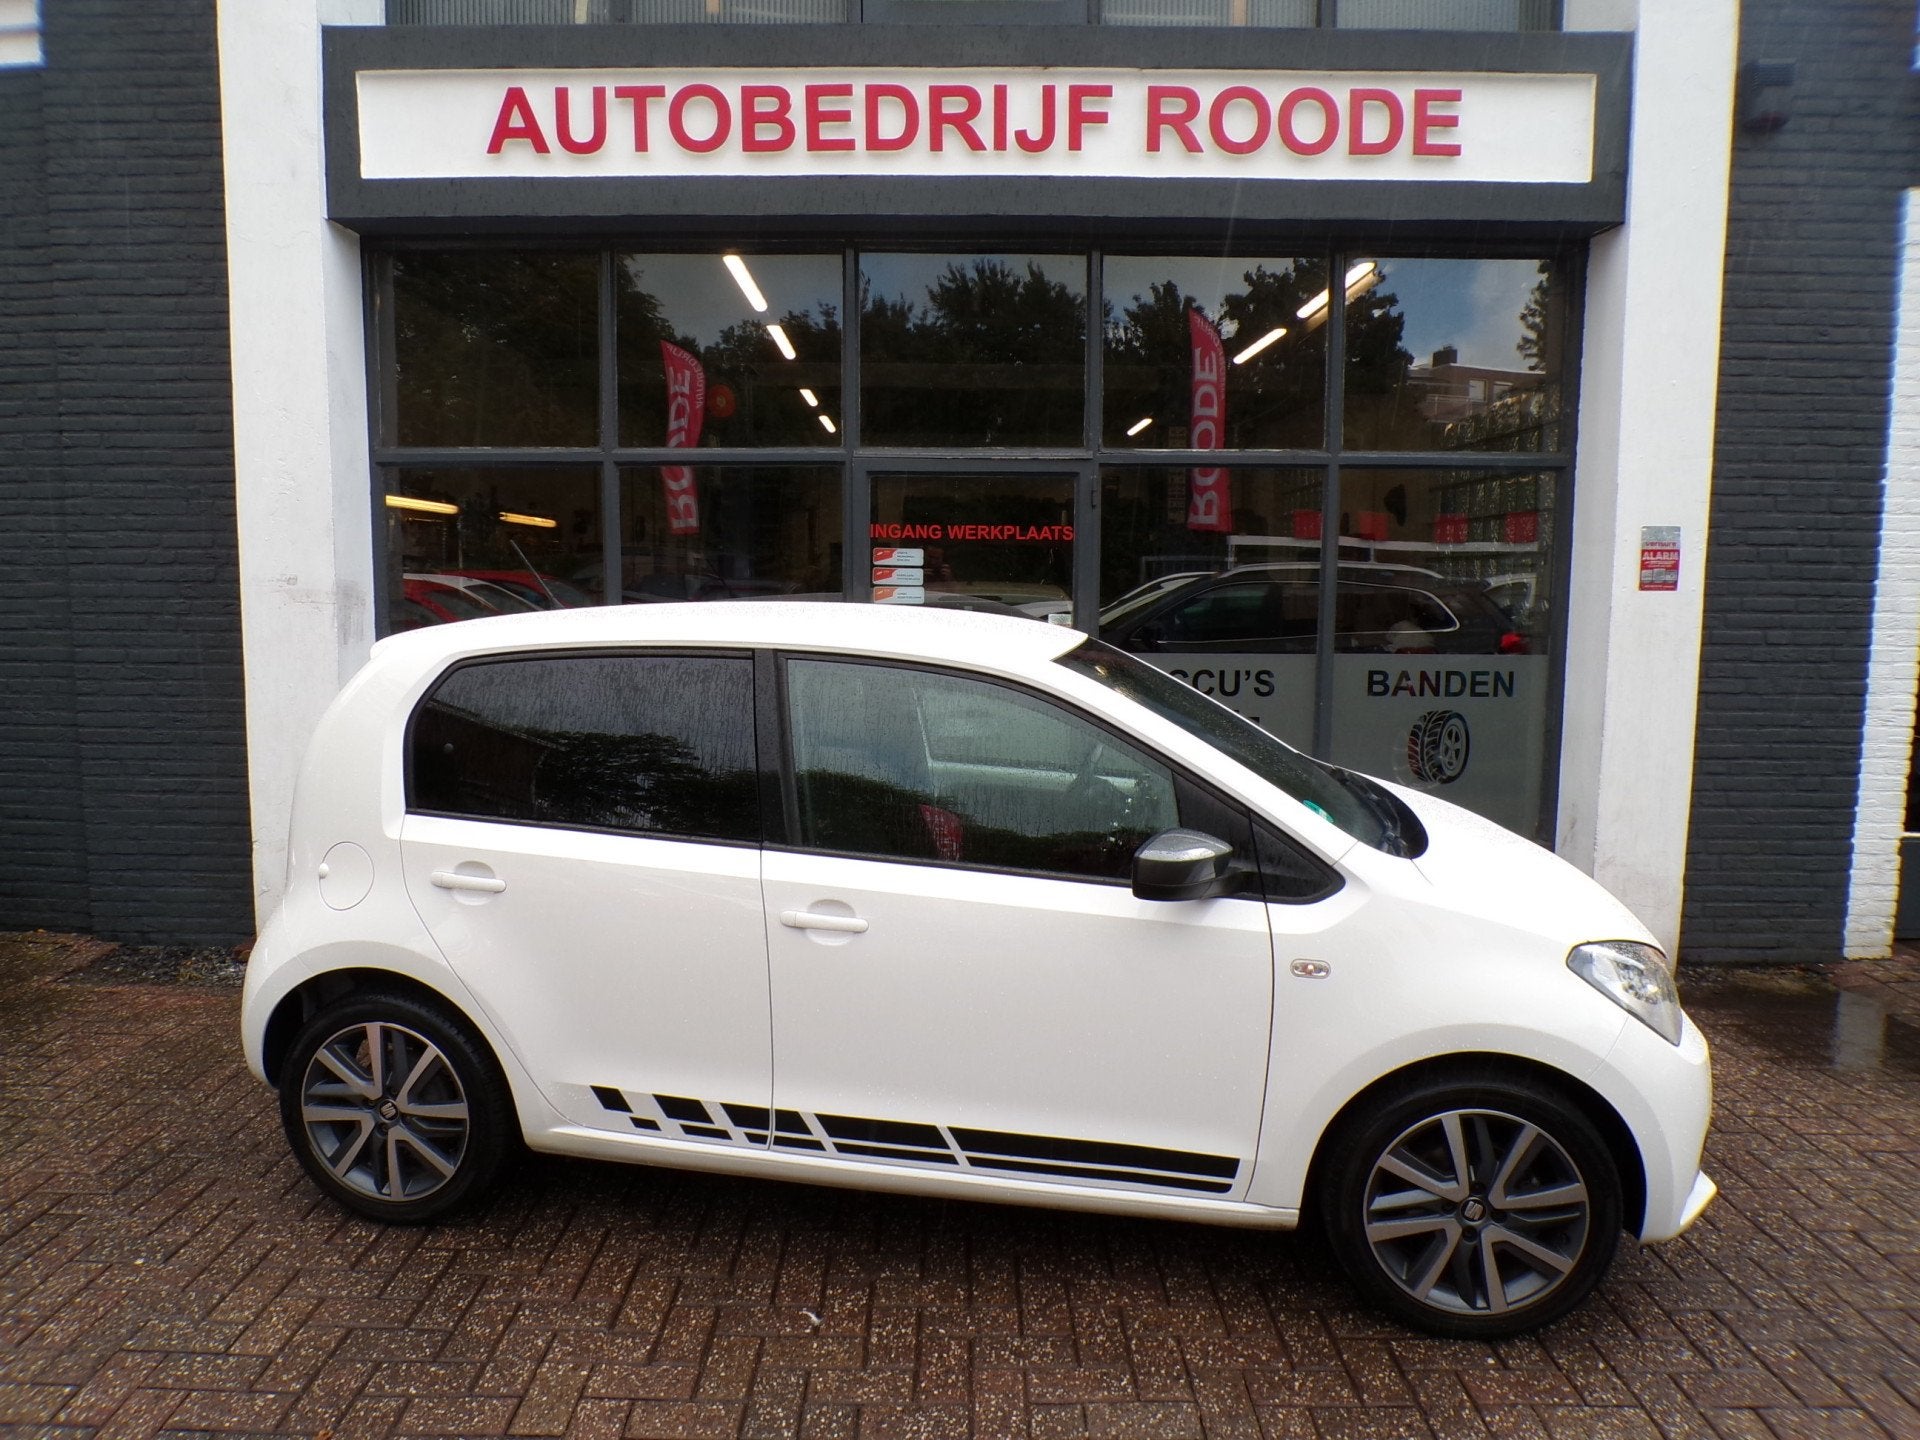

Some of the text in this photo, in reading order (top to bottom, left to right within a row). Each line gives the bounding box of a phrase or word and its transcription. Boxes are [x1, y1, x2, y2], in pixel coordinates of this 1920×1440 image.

[487, 83, 1462, 156] AUTOBEDRIJF ROODE
[870, 523, 1074, 541] INGANG WERKPLAATS
[1642, 551, 1679, 561] ALARM
[1367, 670, 1515, 698] BANDEN
